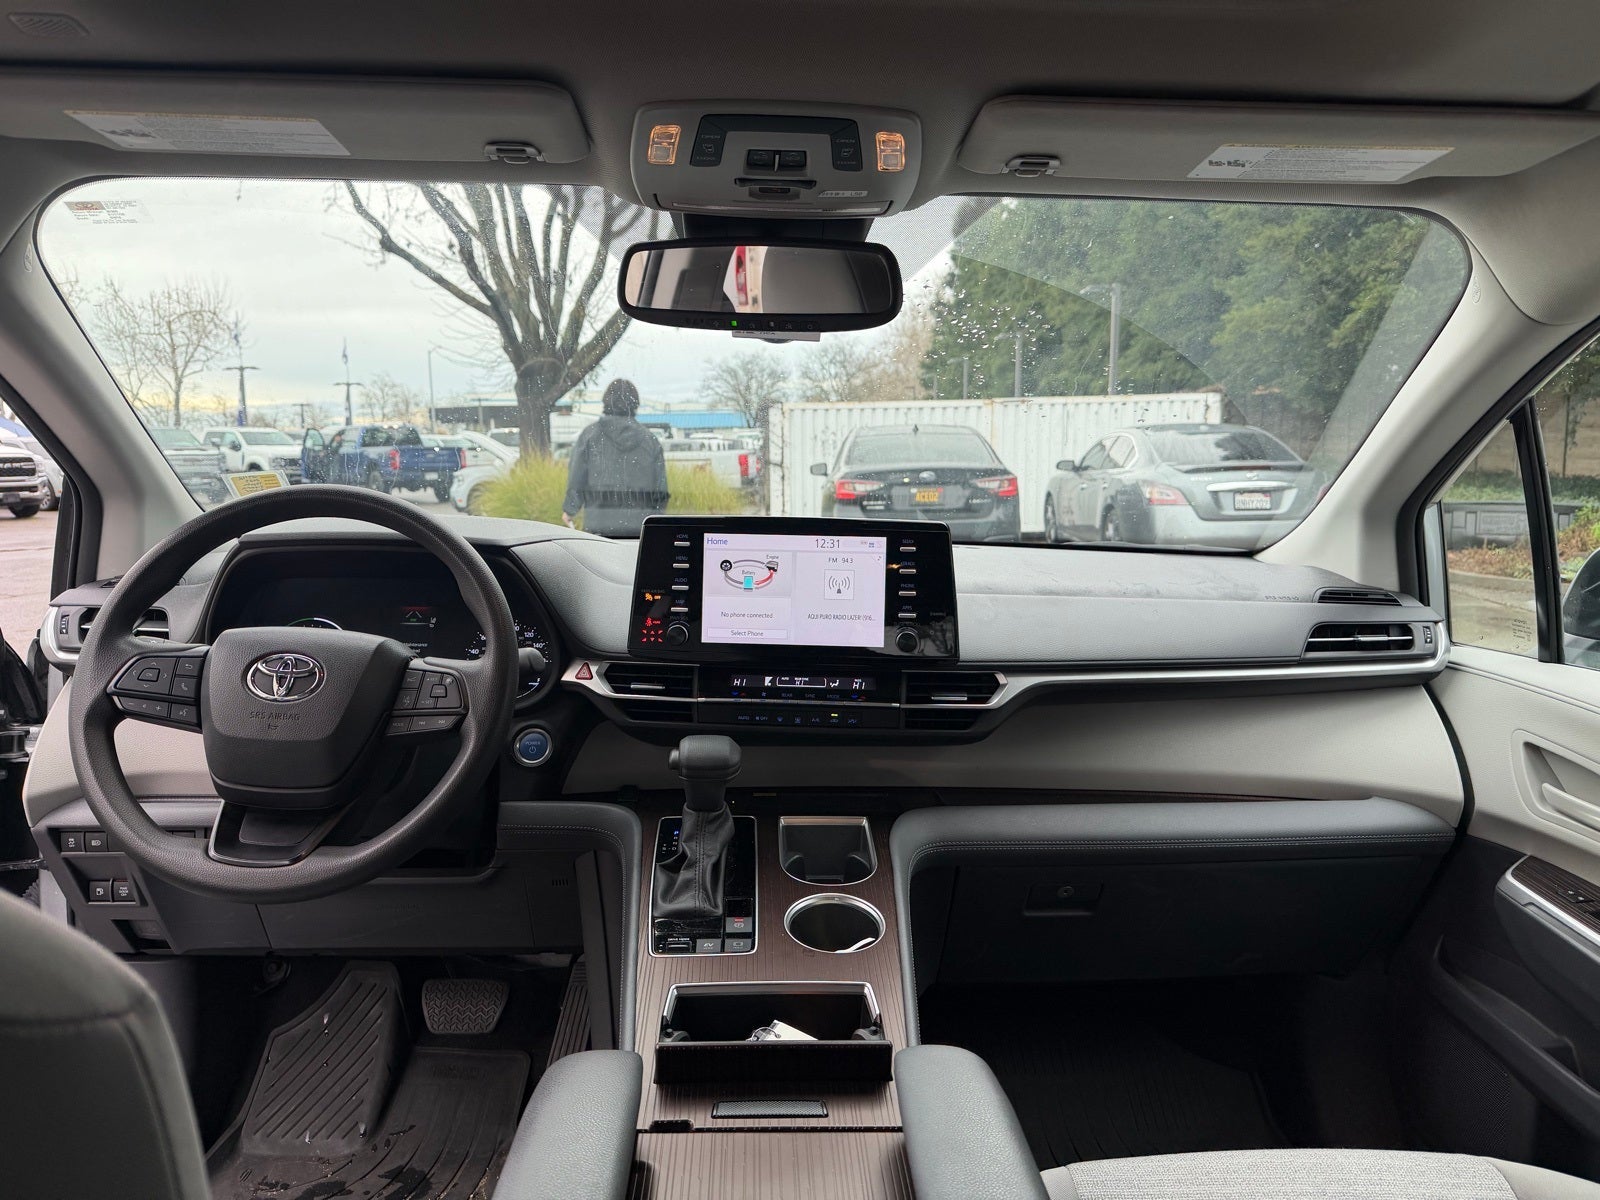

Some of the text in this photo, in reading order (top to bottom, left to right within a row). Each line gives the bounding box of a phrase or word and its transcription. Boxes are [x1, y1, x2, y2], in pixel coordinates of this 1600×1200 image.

[707, 537, 729, 546] Home
[815, 538, 841, 549] 12:31
[733, 678, 747, 686] HI
[249, 711, 300, 721] SRS AIRBAG
